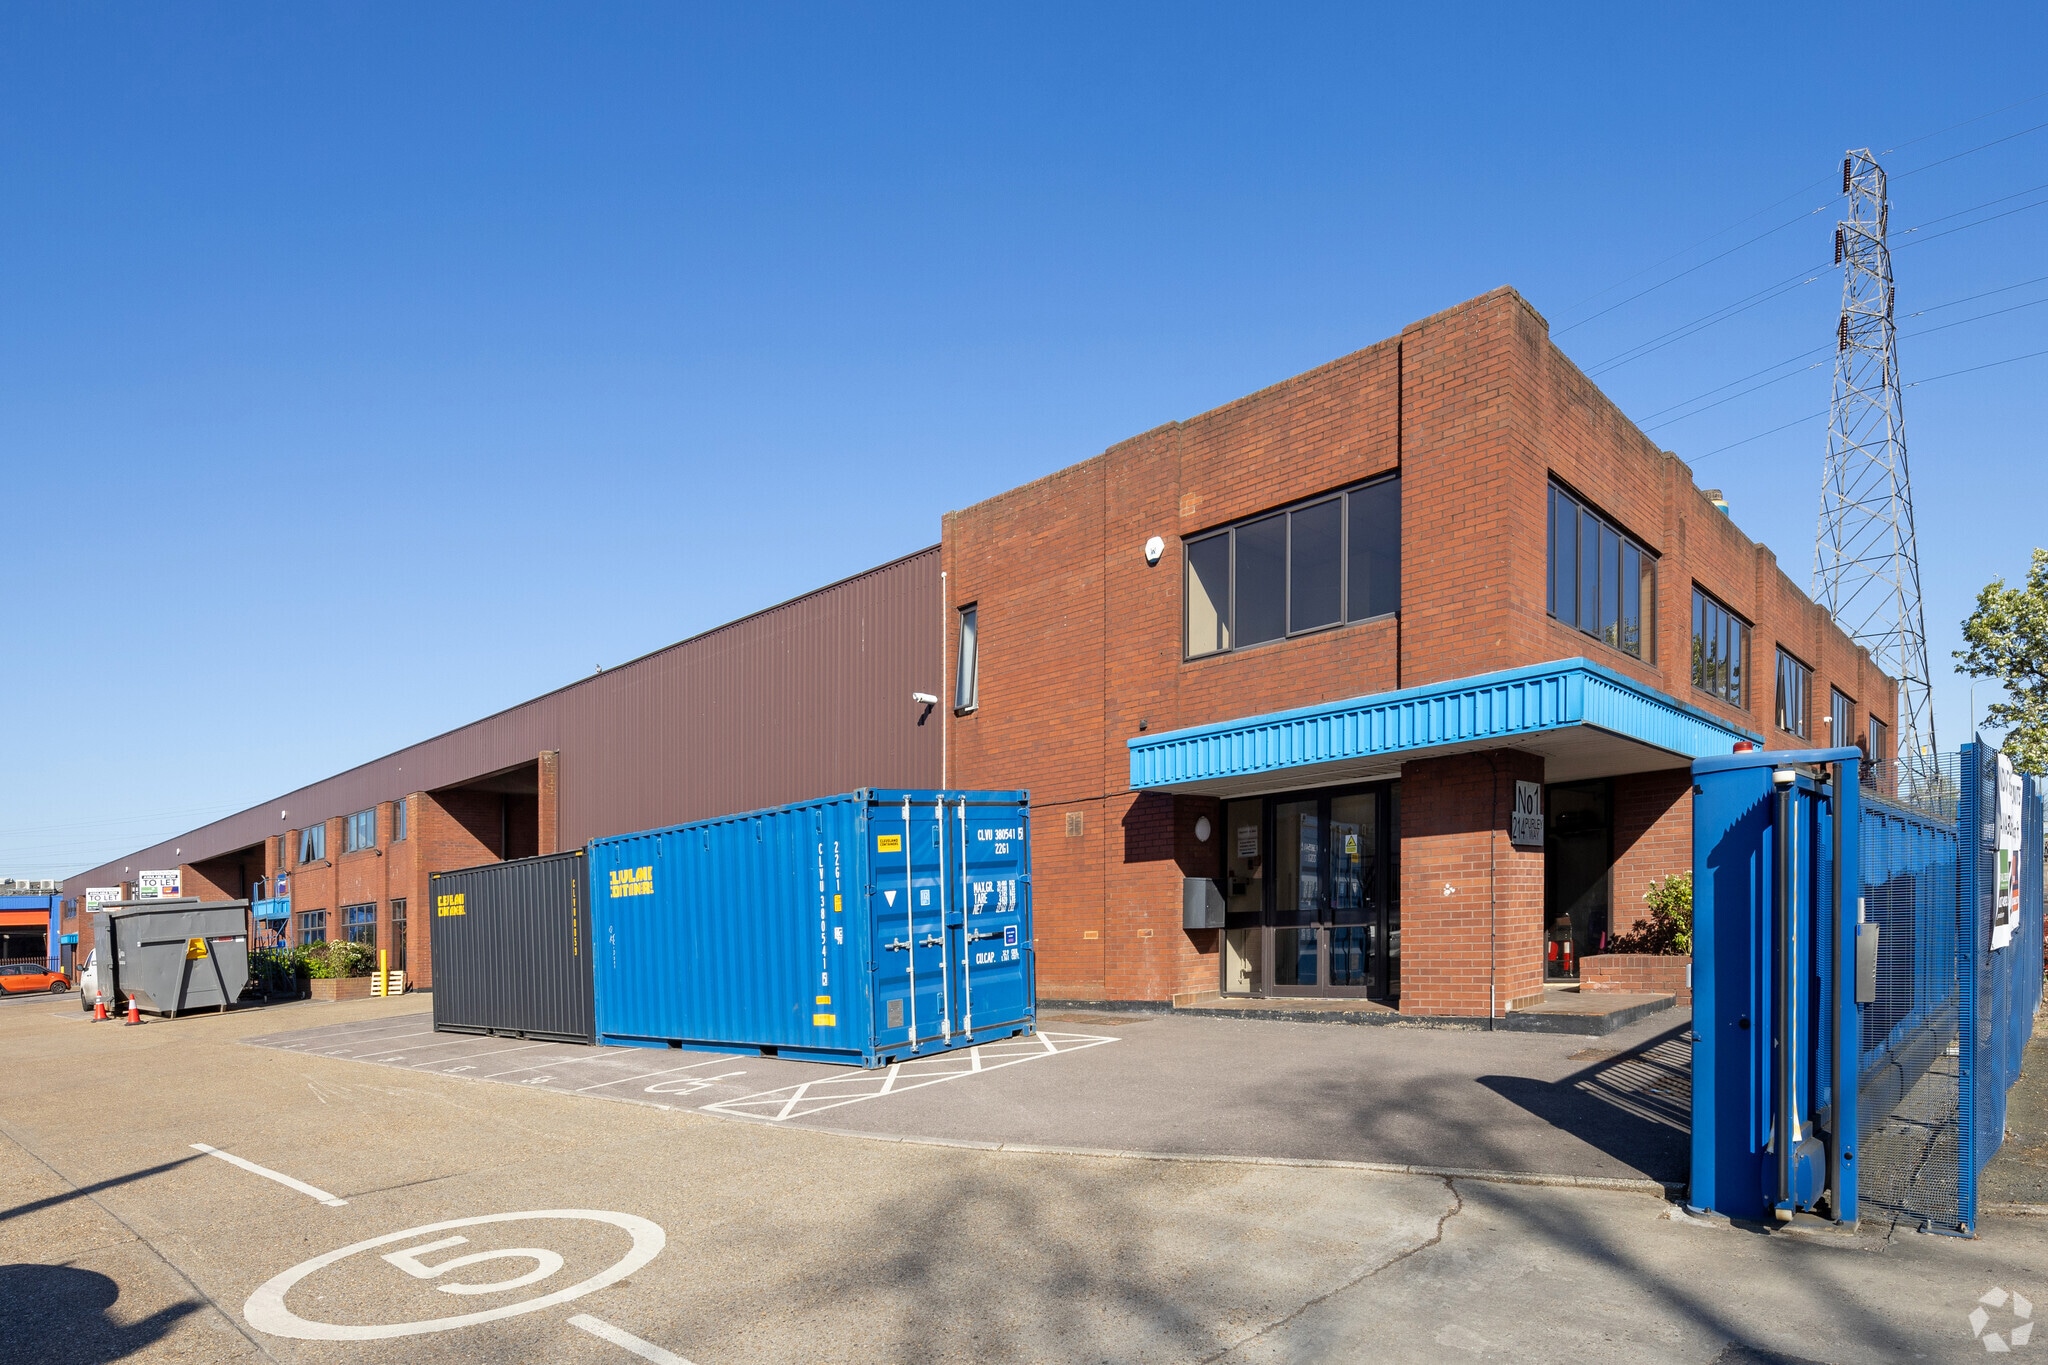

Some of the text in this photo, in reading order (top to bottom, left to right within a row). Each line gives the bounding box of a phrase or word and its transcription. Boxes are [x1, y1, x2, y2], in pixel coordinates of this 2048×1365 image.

[977, 829, 993, 841] CLVU
[994, 828, 1016, 840] 380541
[1513, 817, 1526, 839] 214
[994, 842, 1009, 855] 22G1
[974, 892, 988, 905] TARE
[972, 903, 984, 915] NET
[381, 1235, 564, 1295] 5
